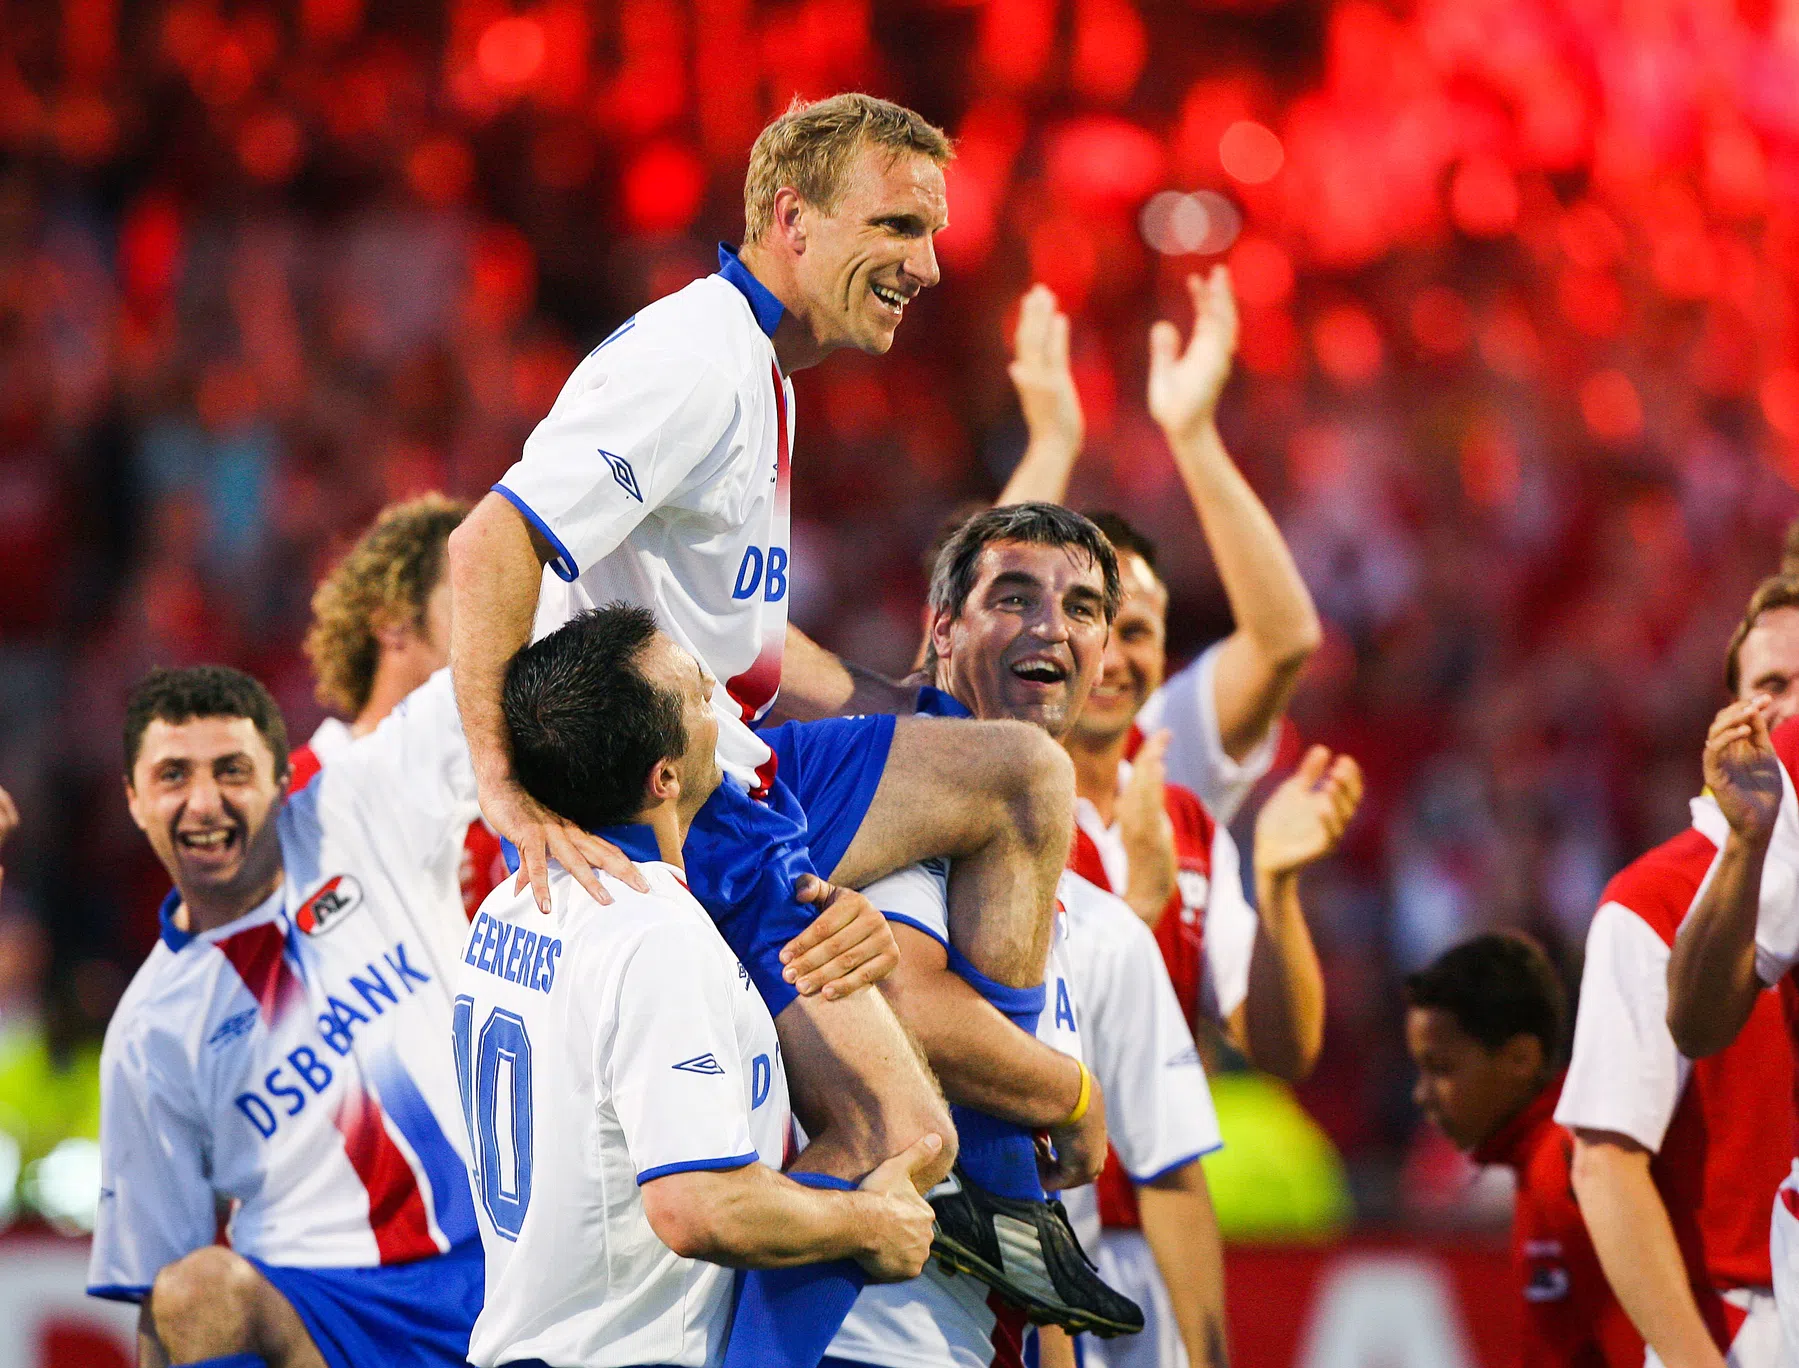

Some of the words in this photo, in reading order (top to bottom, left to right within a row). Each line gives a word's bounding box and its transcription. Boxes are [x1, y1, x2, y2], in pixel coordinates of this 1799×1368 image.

[314, 891, 351, 926] AZ
[460, 912, 562, 994] EEKERES
[236, 1046, 332, 1138] DSB
[319, 943, 430, 1056] BANK
[752, 1045, 779, 1110] D
[452, 994, 533, 1242] 10
